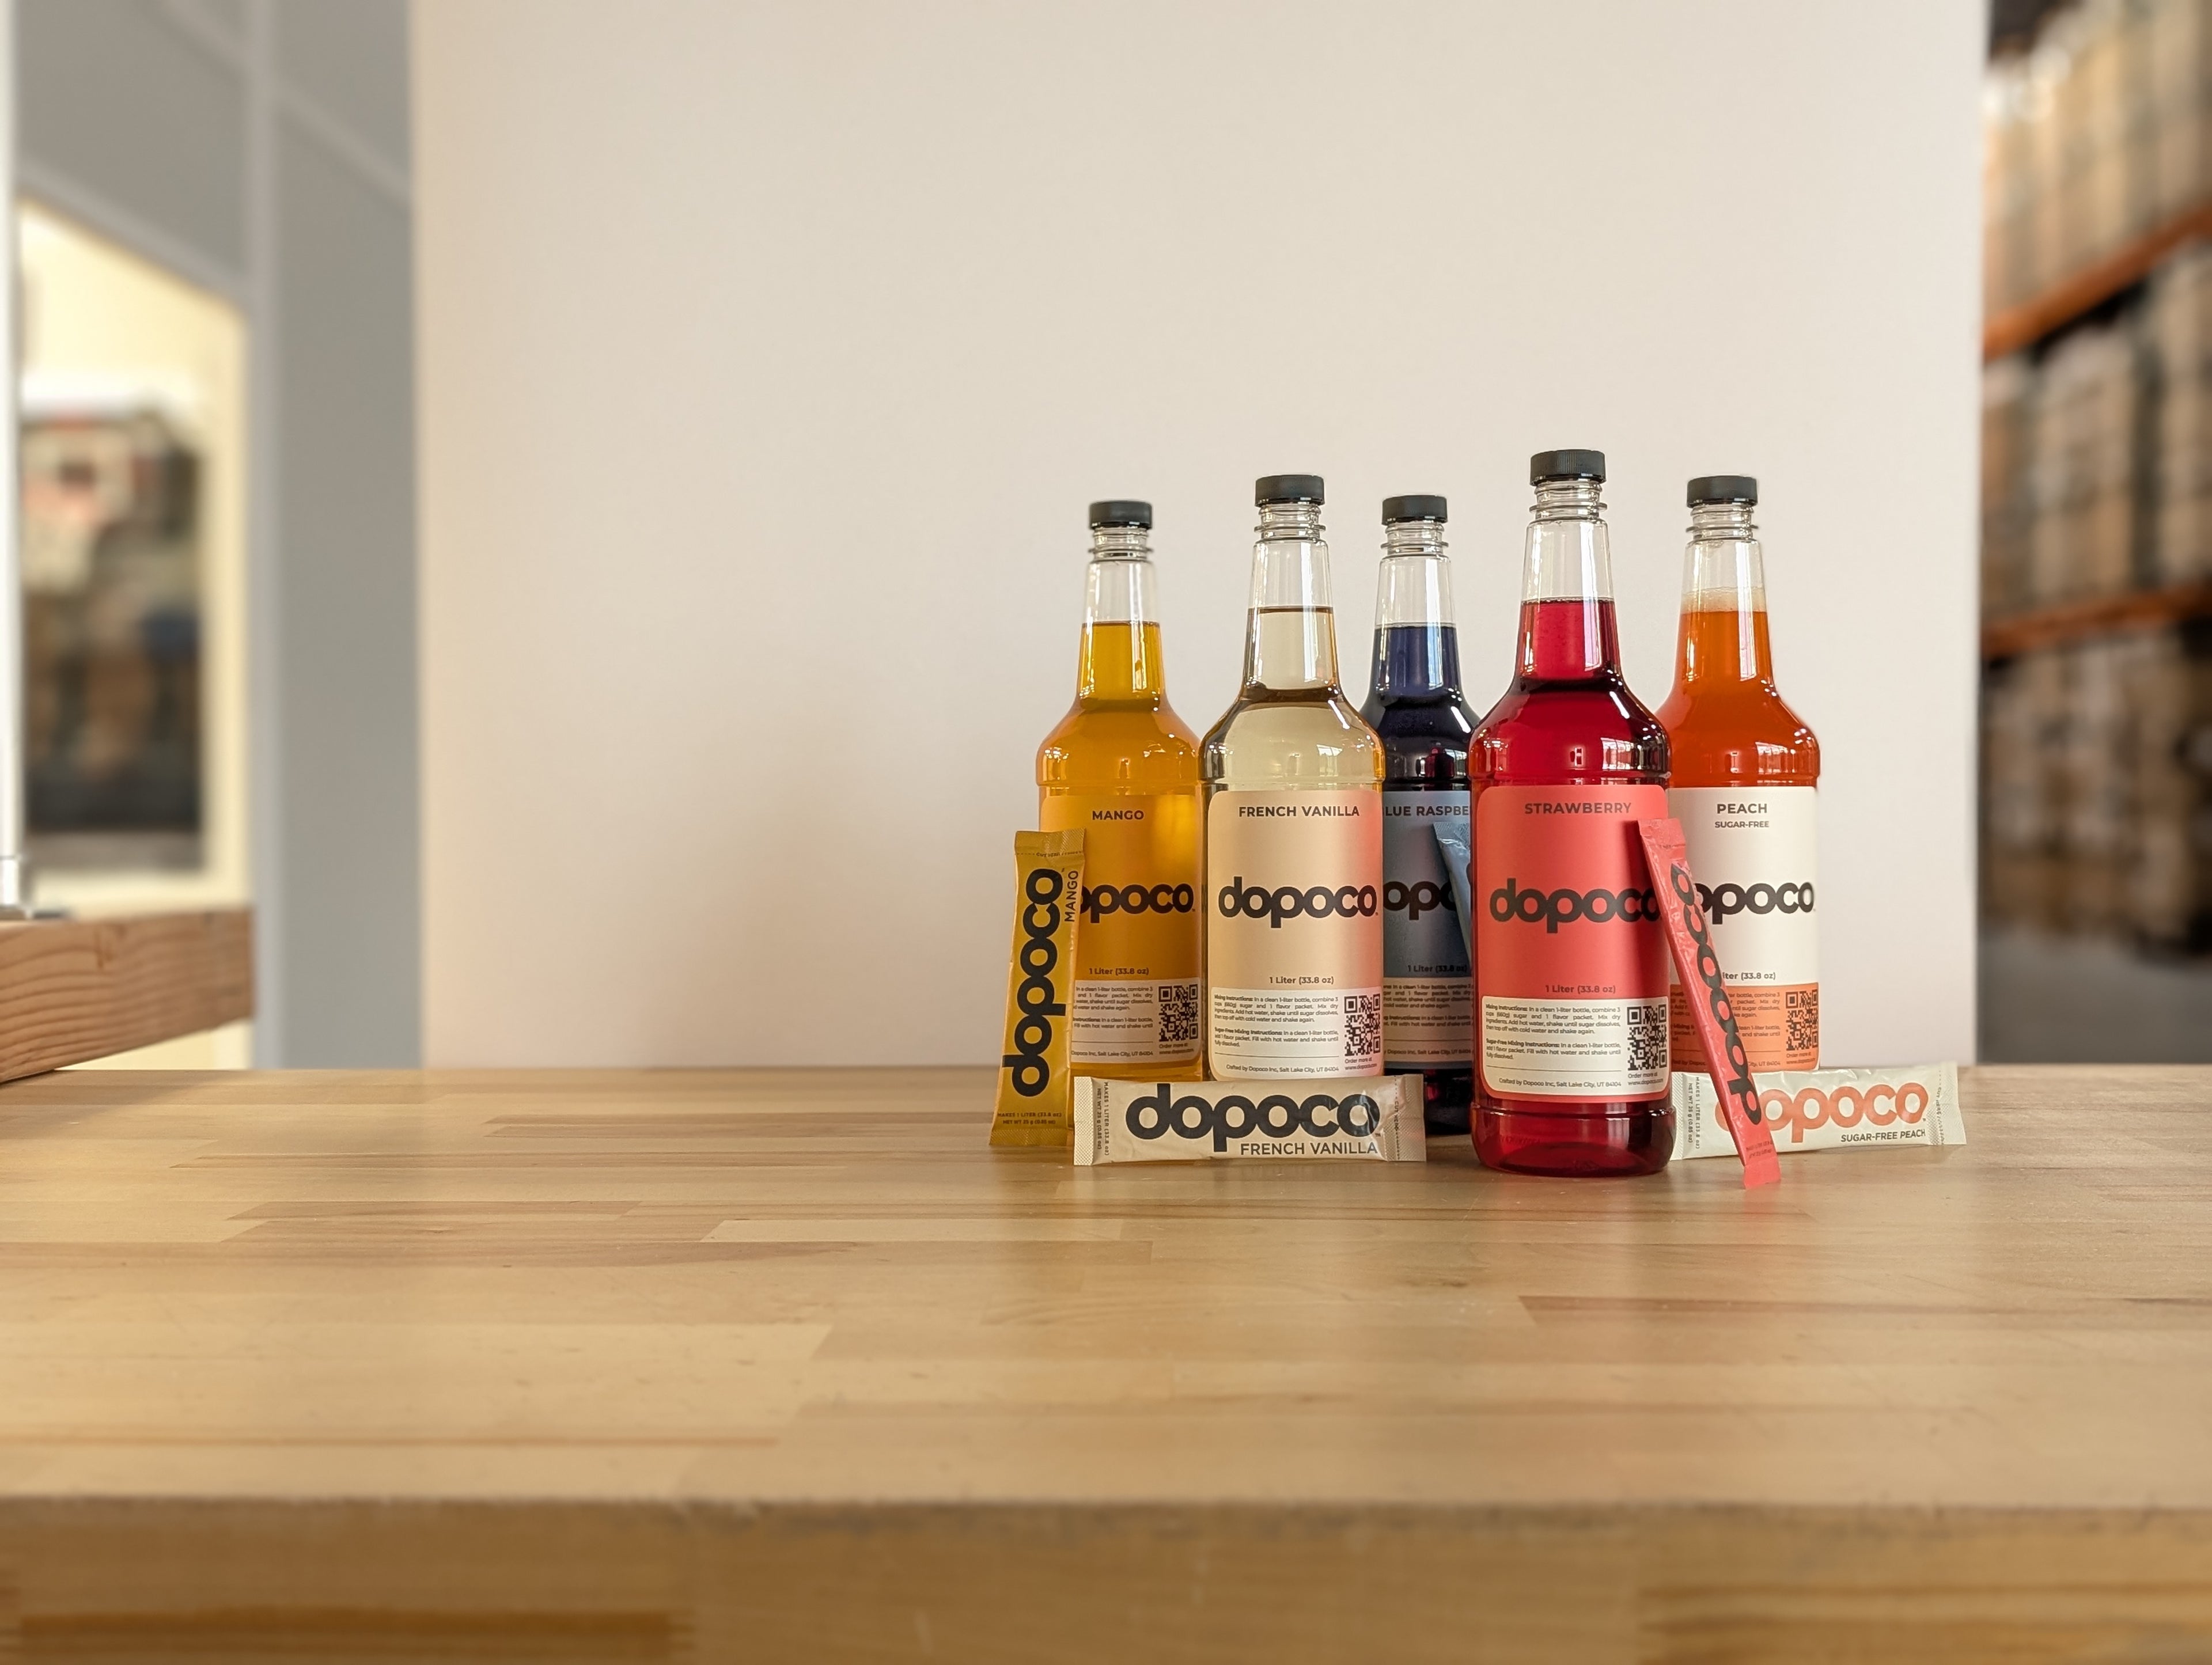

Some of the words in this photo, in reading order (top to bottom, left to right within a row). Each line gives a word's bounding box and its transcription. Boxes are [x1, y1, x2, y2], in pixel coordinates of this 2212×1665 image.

[1239, 806, 1297, 817] FRENCH
[1302, 806, 1360, 816] VANILLA
[1384, 806, 1411, 817] LUE
[1416, 806, 1469, 816] RASPBE
[1524, 803, 1631, 815] STRAWBERRY
[1717, 803, 1768, 814] PEACH
[1092, 810, 1144, 820] MANGO
[1065, 871, 1079, 921] MANGO
[1080, 883, 1194, 923] poco
[1218, 877, 1377, 928] dopoco
[1490, 878, 1660, 934] dopoco
[1115, 968, 1134, 976] (33.8
[1456, 965, 1468, 973] oz)
[1298, 976, 1320, 985] (33.8
[1321, 977, 1334, 985] oz)
[1741, 972, 1762, 980] (33.8
[1764, 972, 1776, 980] oz)
[1002, 868, 1066, 1097] dopoco
[1546, 985, 1550, 993] 1
[1552, 985, 1574, 993] Liter
[1577, 985, 1600, 994] (33.8
[1603, 985, 1616, 994] oz)
[1670, 863, 1762, 1124] dopoco
[1688, 1095, 1693, 1105] WT
[1126, 1083, 1380, 1152] dopoco
[1840, 1132, 1897, 1143] SUGAR-FREE
[1900, 1129, 1926, 1139] PEACH
[1240, 1143, 1304, 1155] FRENCH
[1310, 1141, 1378, 1155] VANILLA
